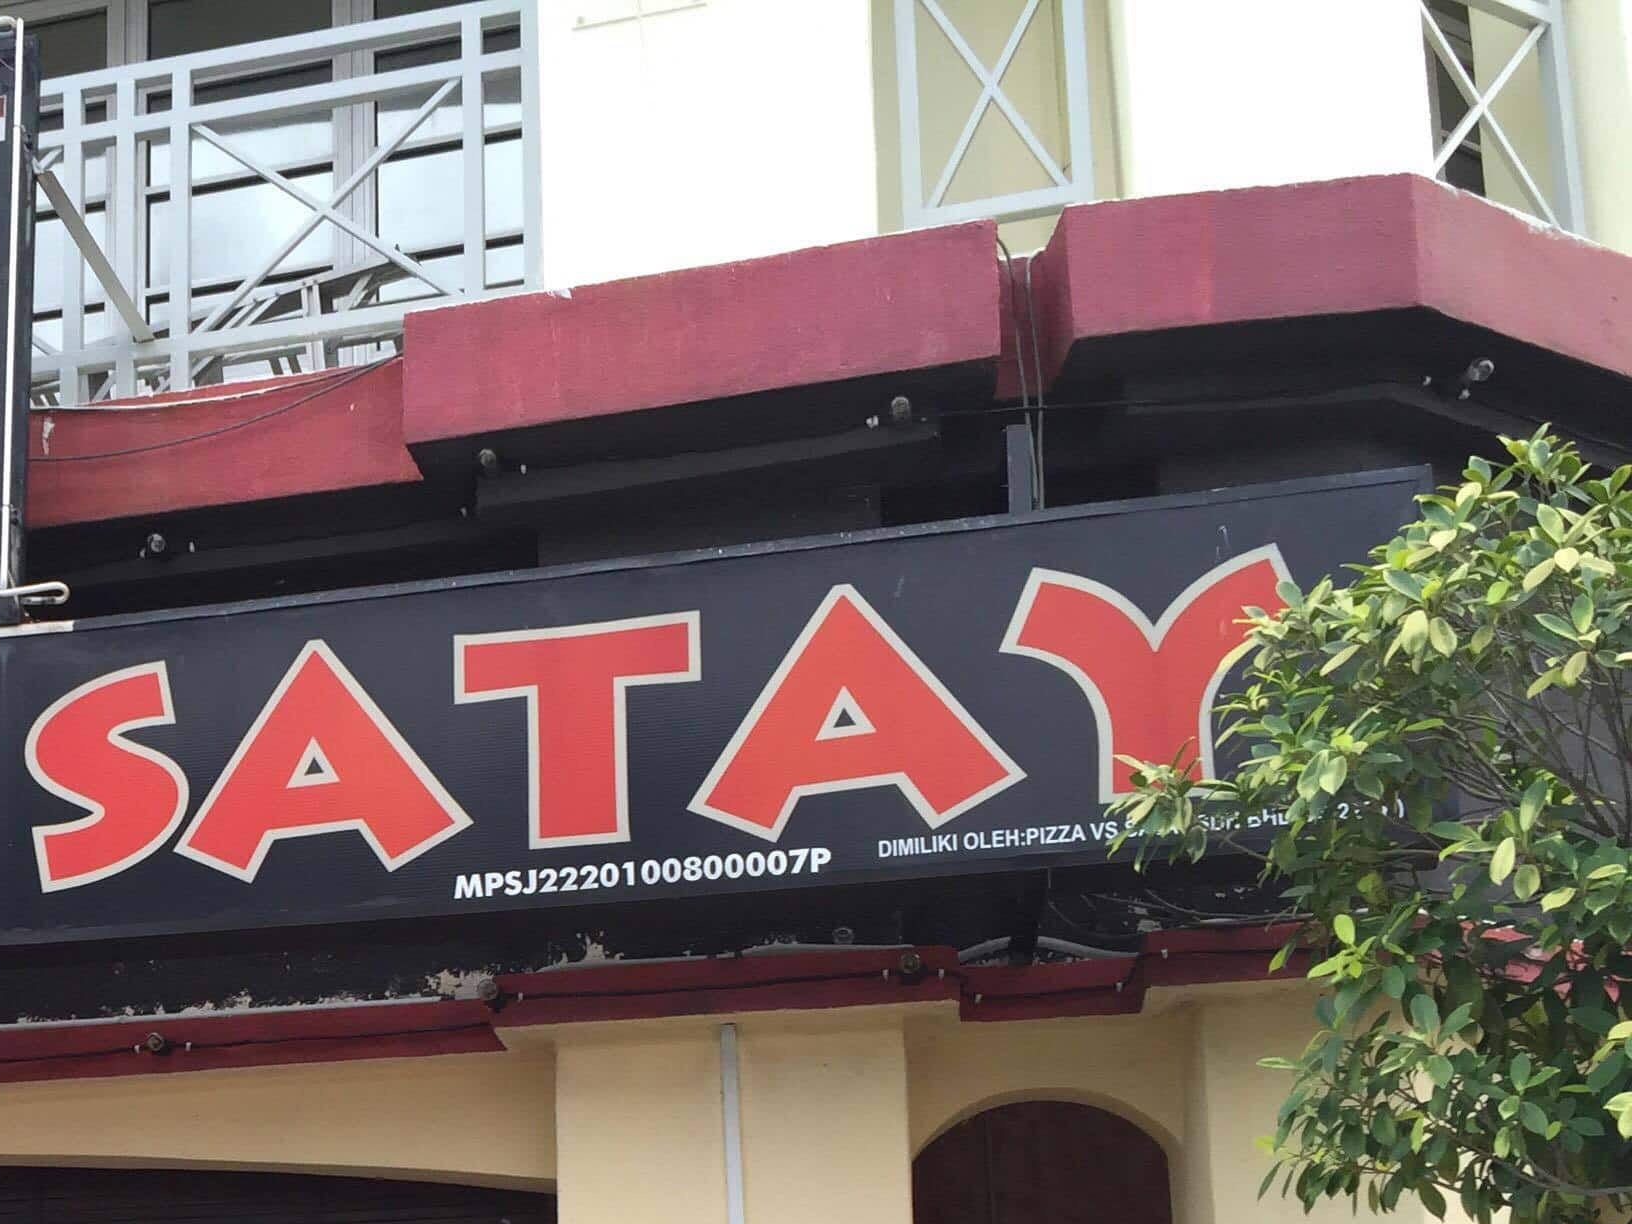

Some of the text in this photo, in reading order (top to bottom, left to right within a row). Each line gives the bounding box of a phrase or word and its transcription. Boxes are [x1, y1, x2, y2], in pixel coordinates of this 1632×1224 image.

[24, 542, 1298, 893] SATAY
[878, 833, 958, 858] DIMILIKI
[1090, 820, 1118, 841] VS
[453, 847, 832, 900] MPSJ2220100800007P
